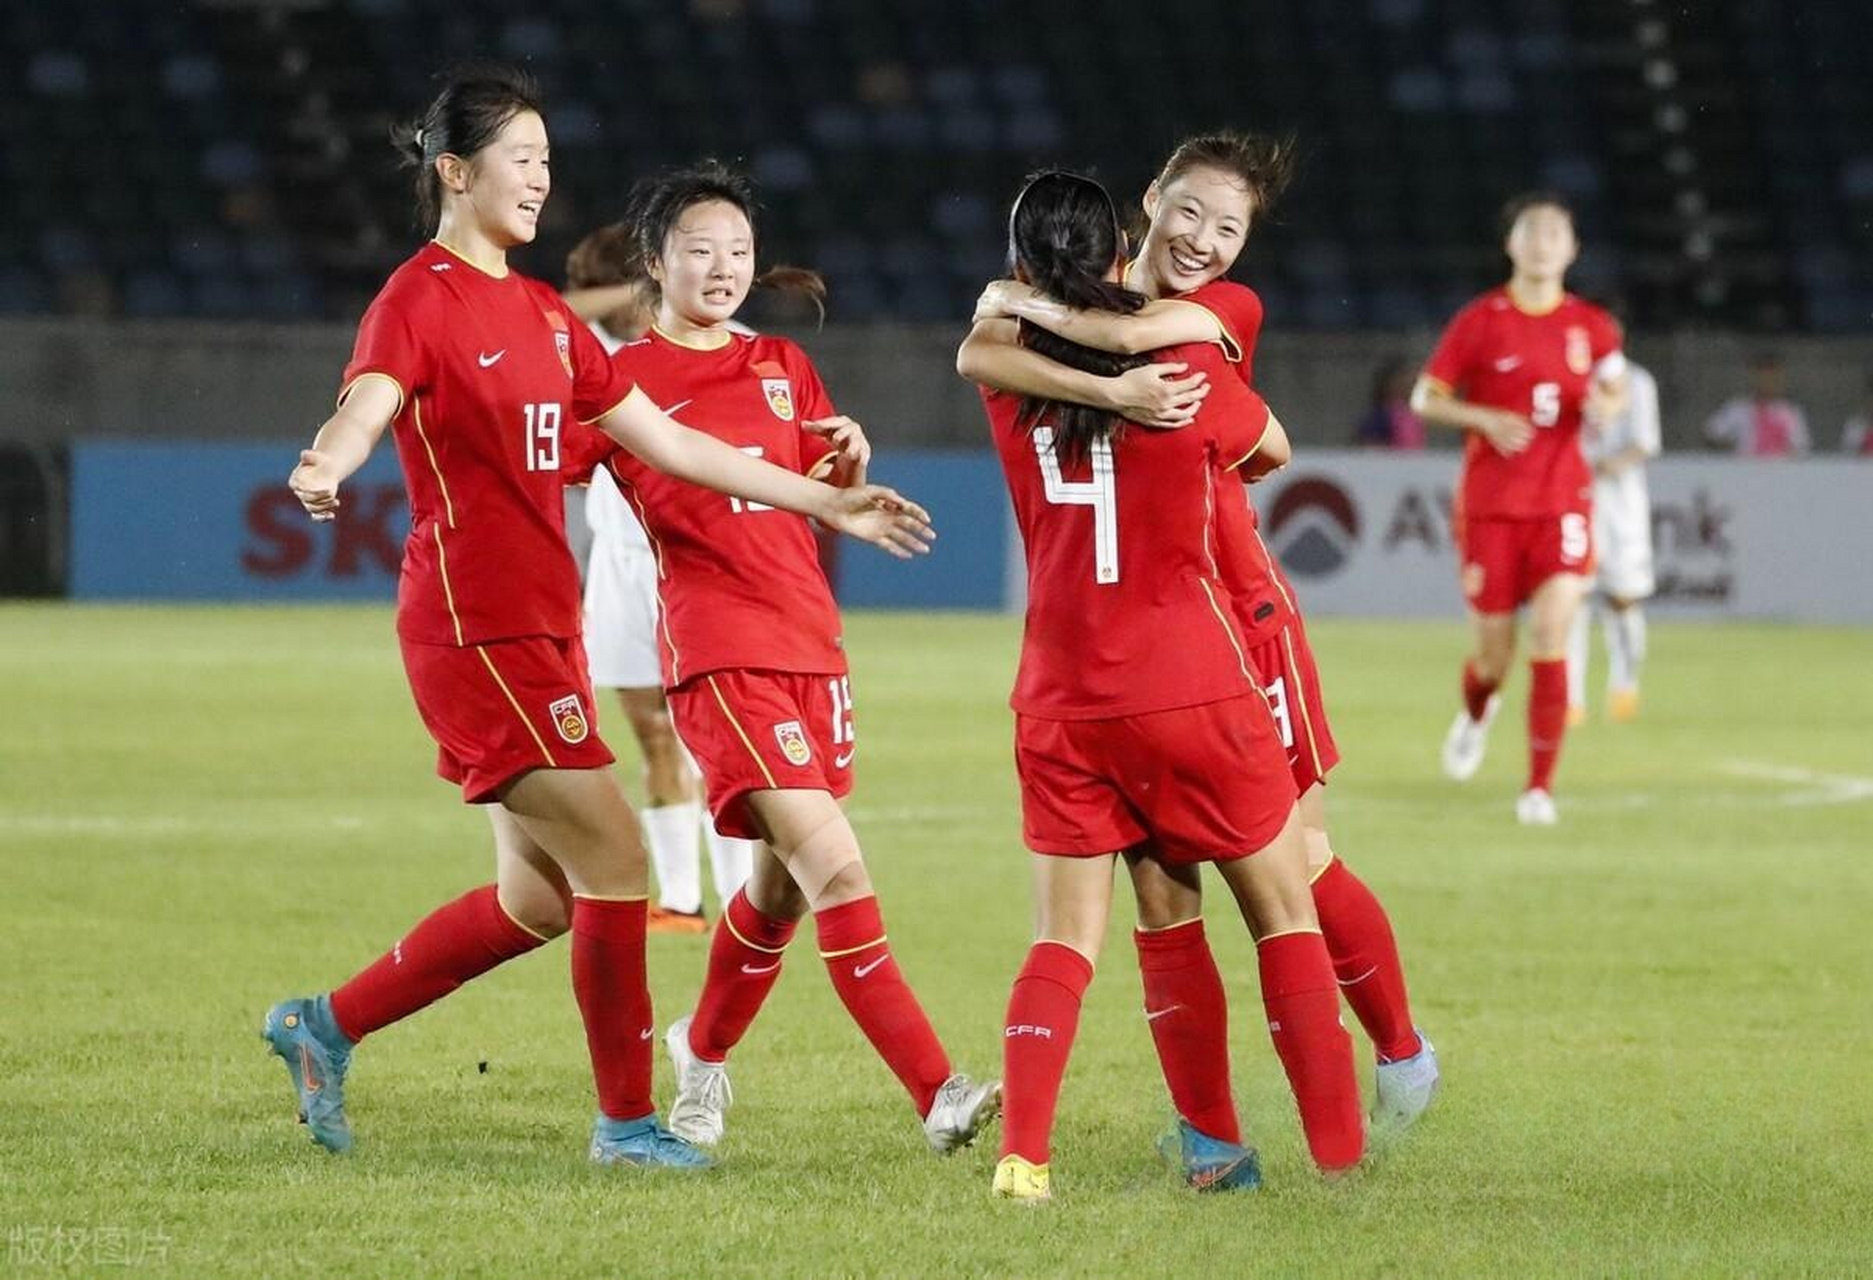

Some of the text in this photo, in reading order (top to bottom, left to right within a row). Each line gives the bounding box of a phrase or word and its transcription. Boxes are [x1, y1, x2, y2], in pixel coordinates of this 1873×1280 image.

[524, 403, 561, 471] 19
[1532, 382, 1561, 428] 5
[241, 482, 406, 579] SK
[1033, 426, 1119, 584] 4
[1561, 513, 1588, 558] 5
